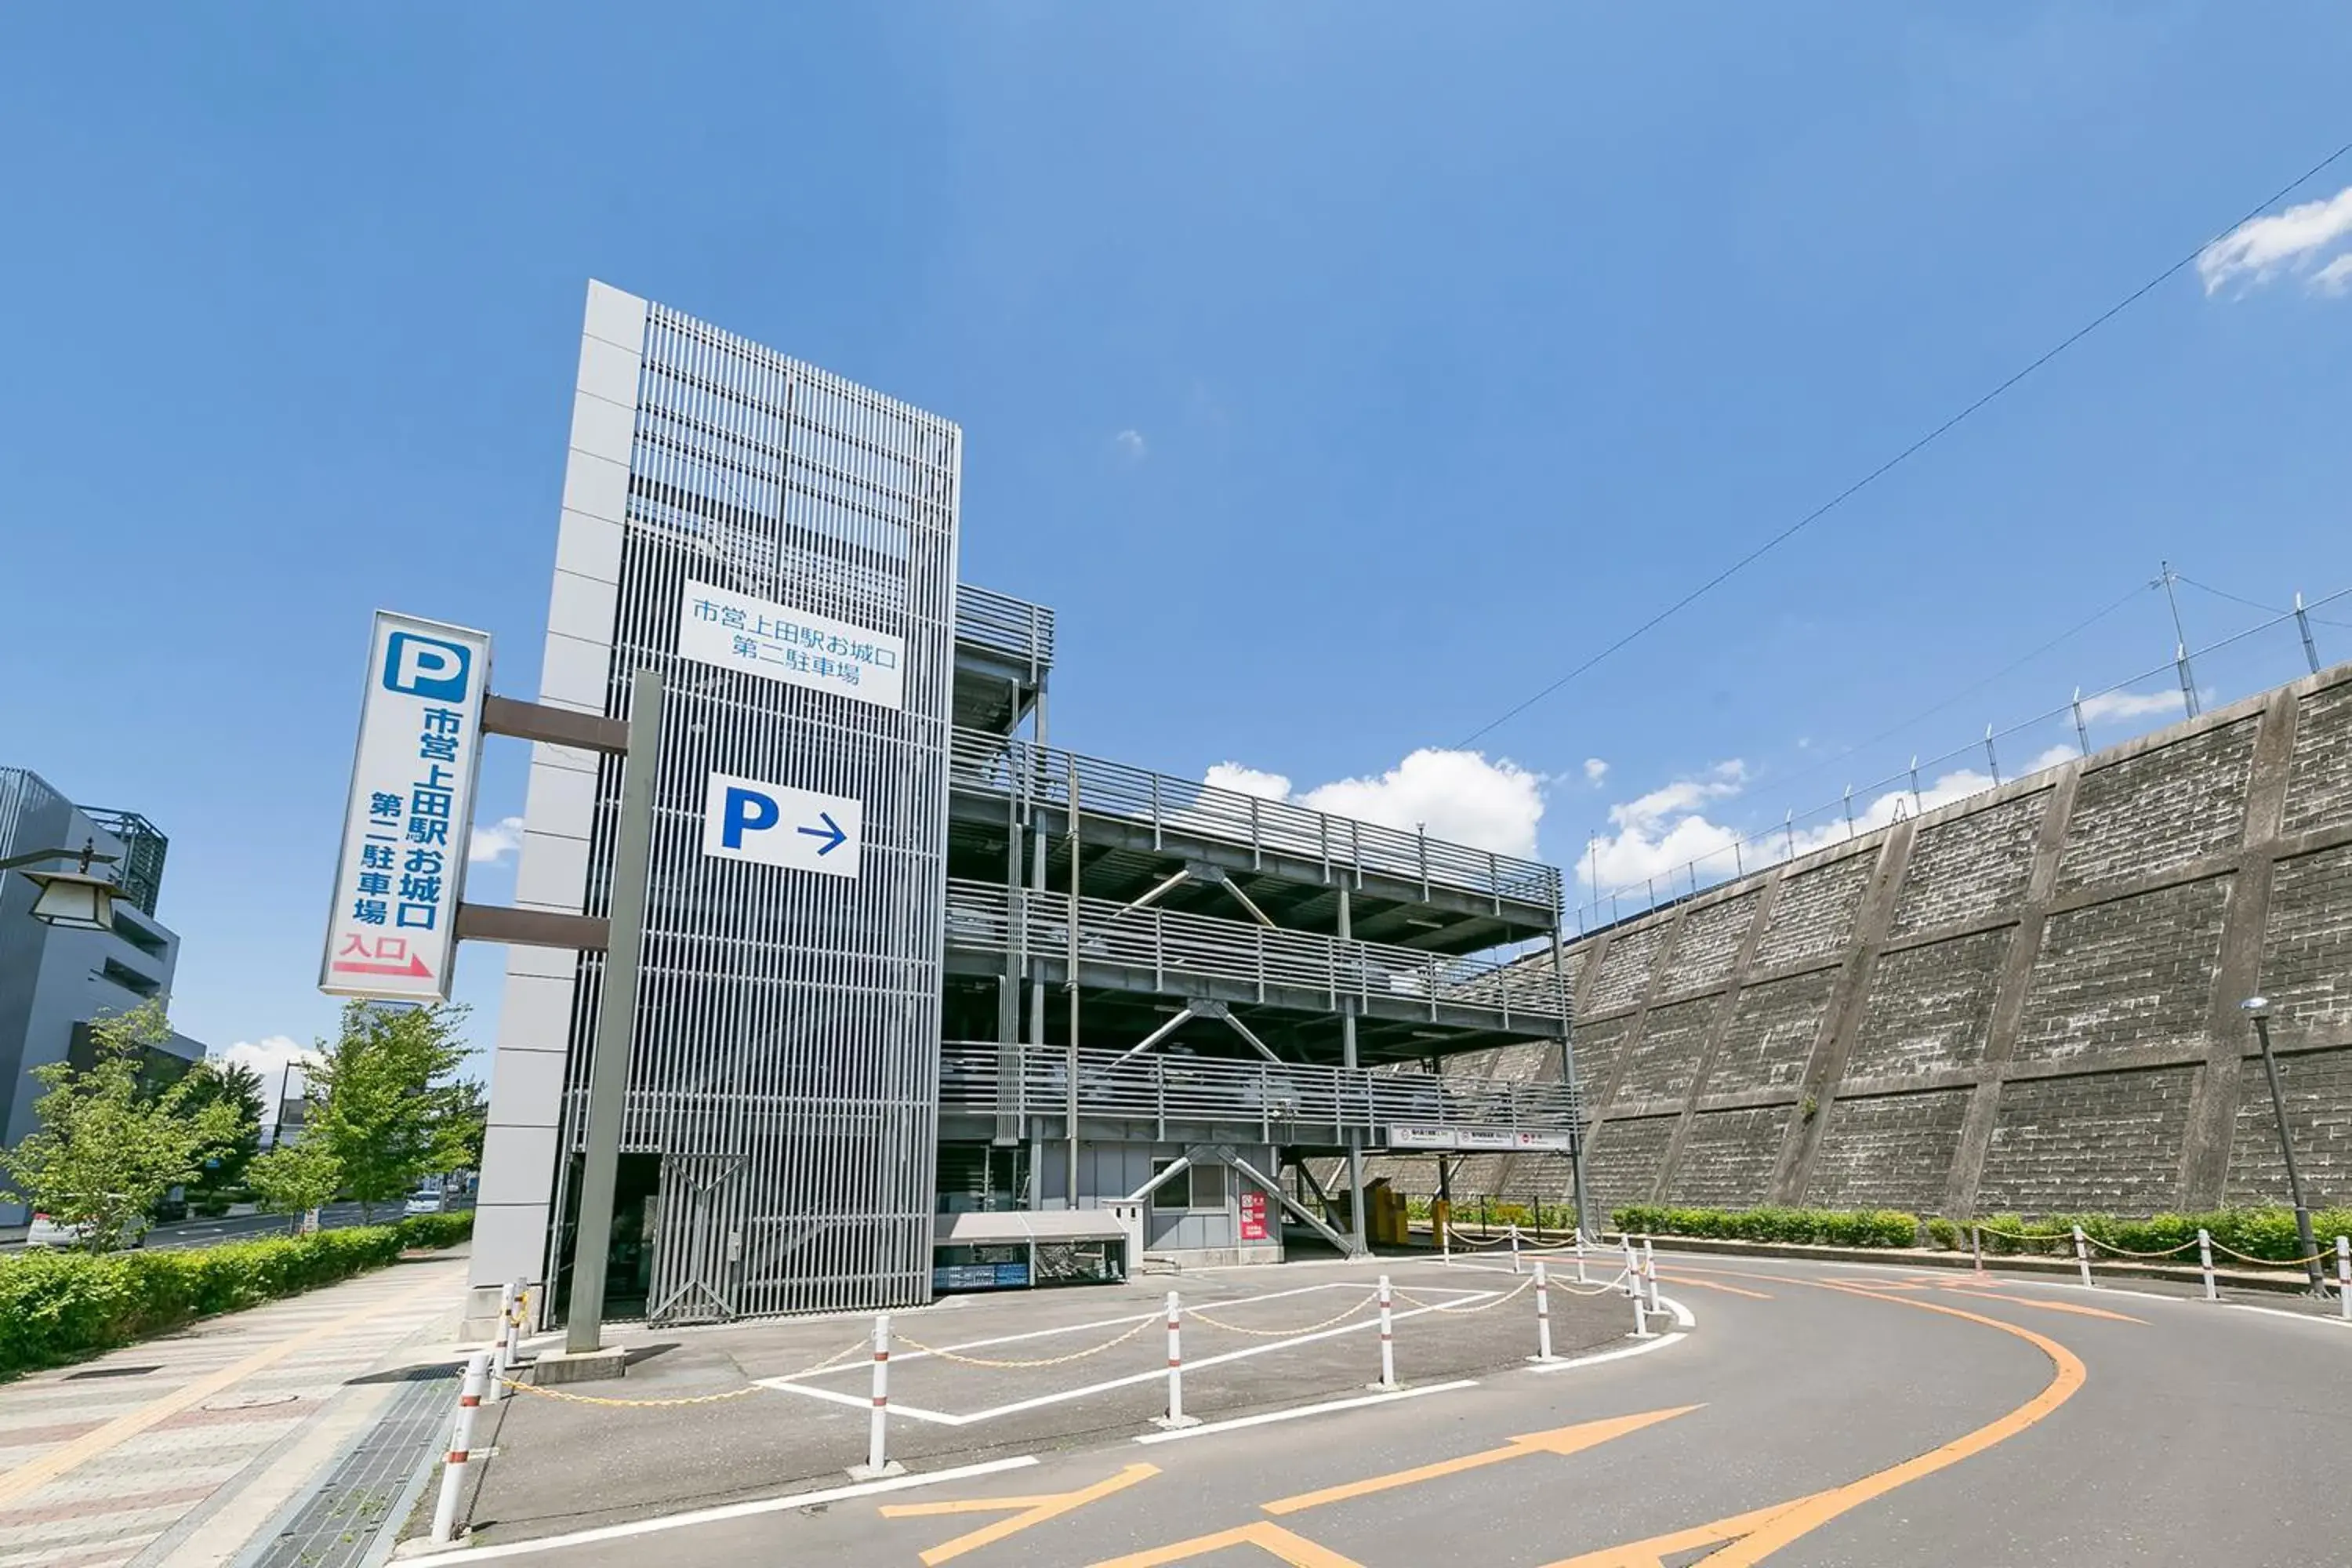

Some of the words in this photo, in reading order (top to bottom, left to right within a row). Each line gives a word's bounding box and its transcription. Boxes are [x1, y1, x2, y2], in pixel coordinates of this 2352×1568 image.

[397, 638, 463, 689] P
[692, 597, 897, 670] 市営上田駅お城口
[731, 634, 861, 686] 第二駐車場
[396, 707, 463, 931] 市営上田駅お城口
[721, 786, 780, 850] P
[353, 791, 404, 926] 第二駐車場
[338, 932, 408, 961] 入口
